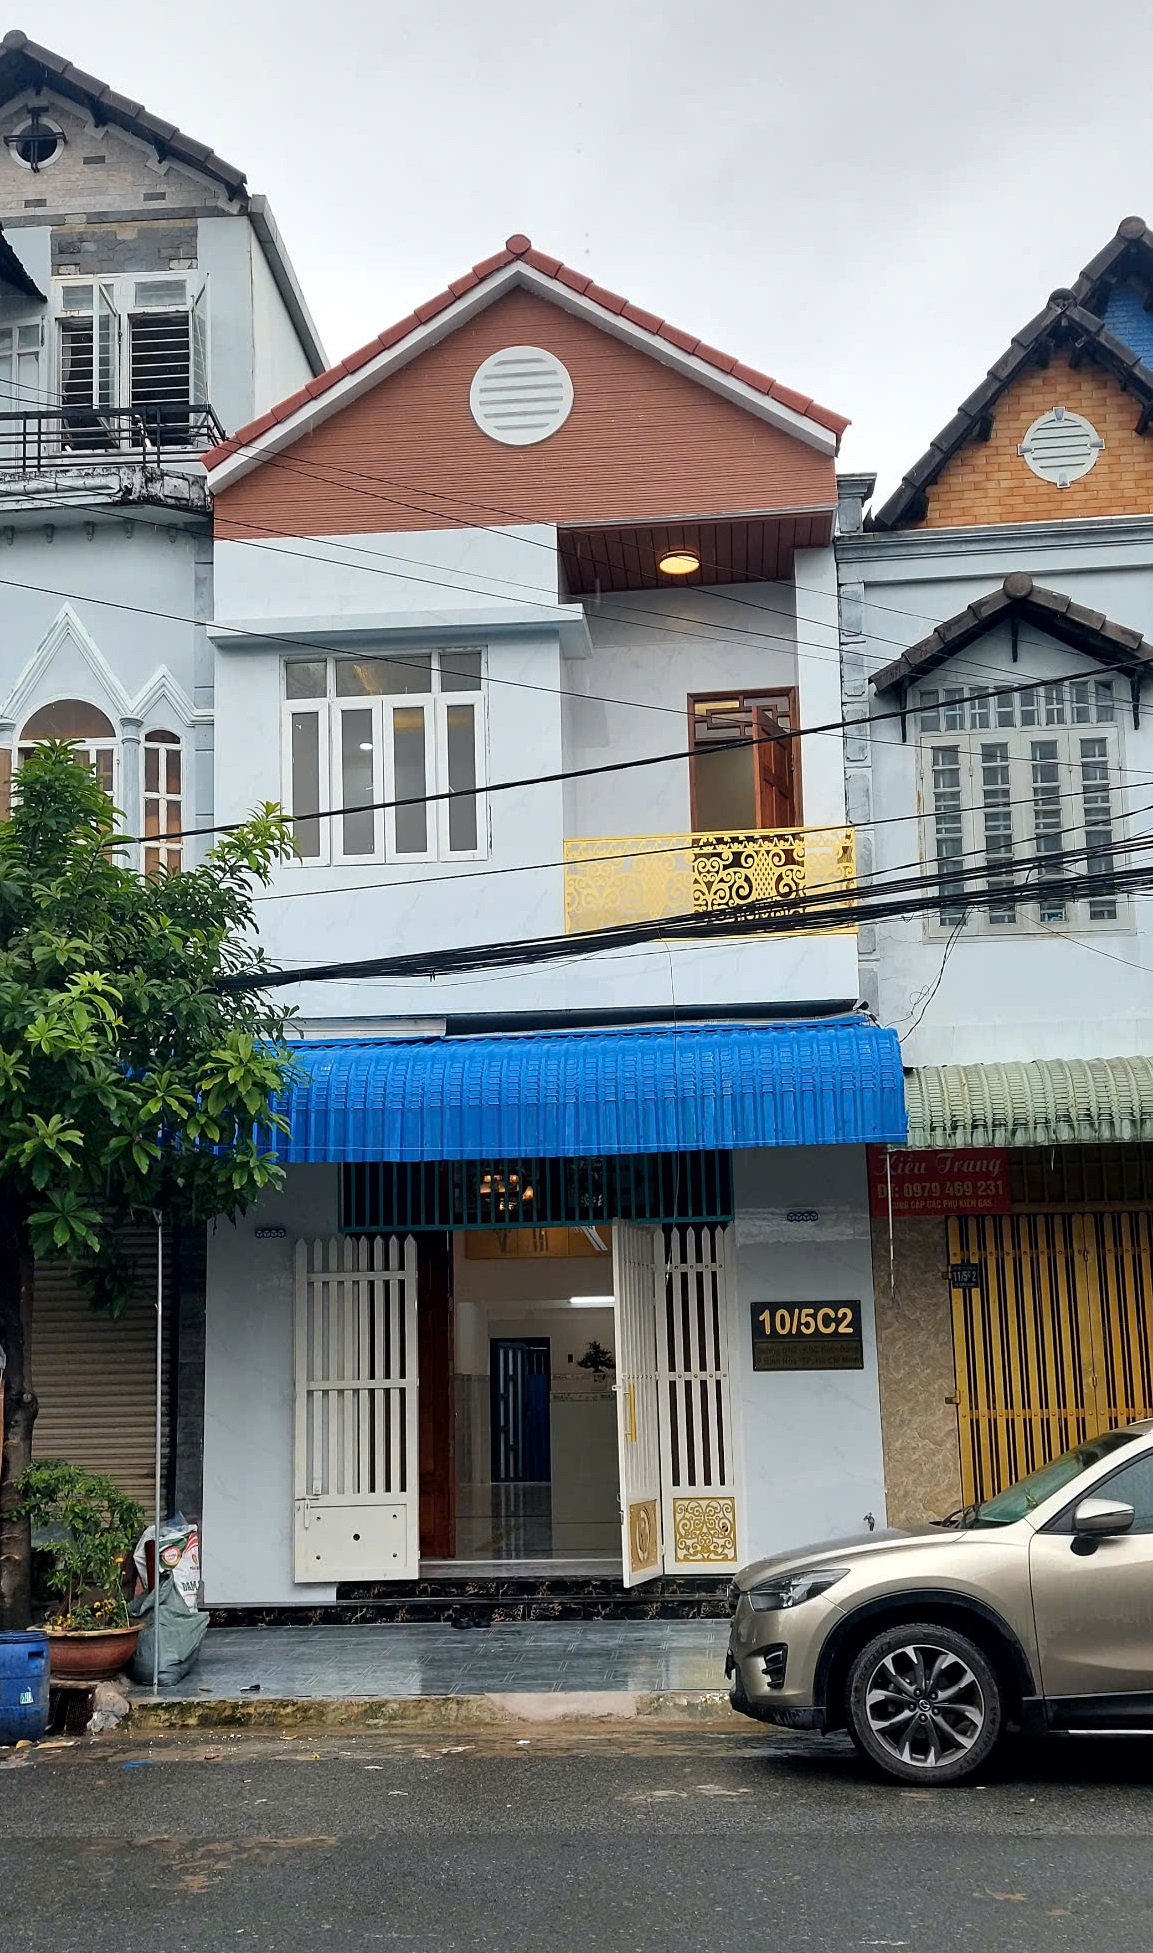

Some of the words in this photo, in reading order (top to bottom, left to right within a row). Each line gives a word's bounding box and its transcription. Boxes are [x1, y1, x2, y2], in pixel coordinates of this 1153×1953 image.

[936, 1152, 1001, 1176] Trang
[903, 1182, 941, 1198] 0979
[945, 1180, 973, 1196] 469
[977, 1179, 1004, 1195] 231
[978, 1199, 992, 1207] GAS
[758, 1308, 854, 1335] 10/5C2
